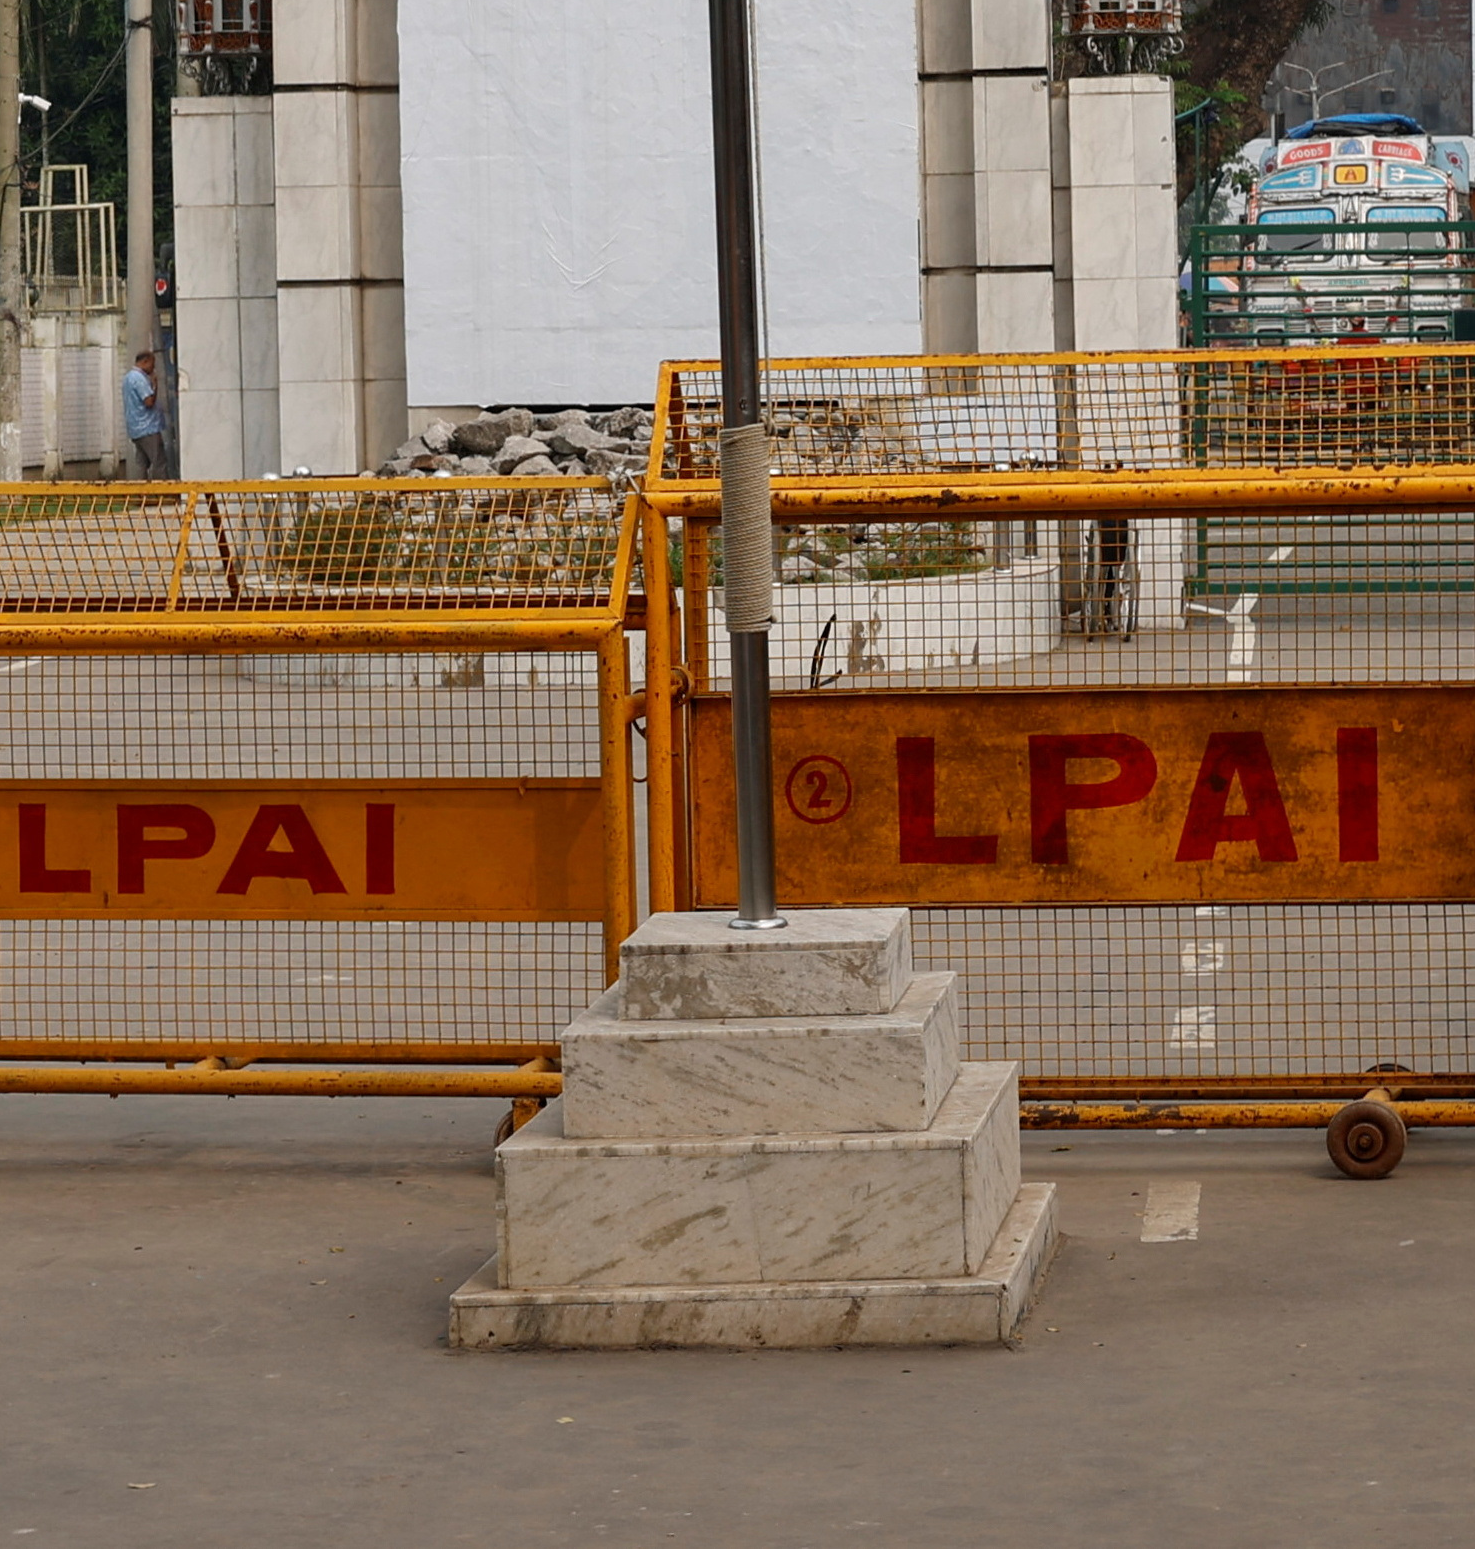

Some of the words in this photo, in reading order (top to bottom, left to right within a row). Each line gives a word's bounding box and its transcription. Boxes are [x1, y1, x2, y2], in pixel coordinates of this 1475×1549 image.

[1290, 145, 1324, 160] GOODS
[896, 727, 1379, 865] LPAI
[18, 803, 396, 895] LPAI
